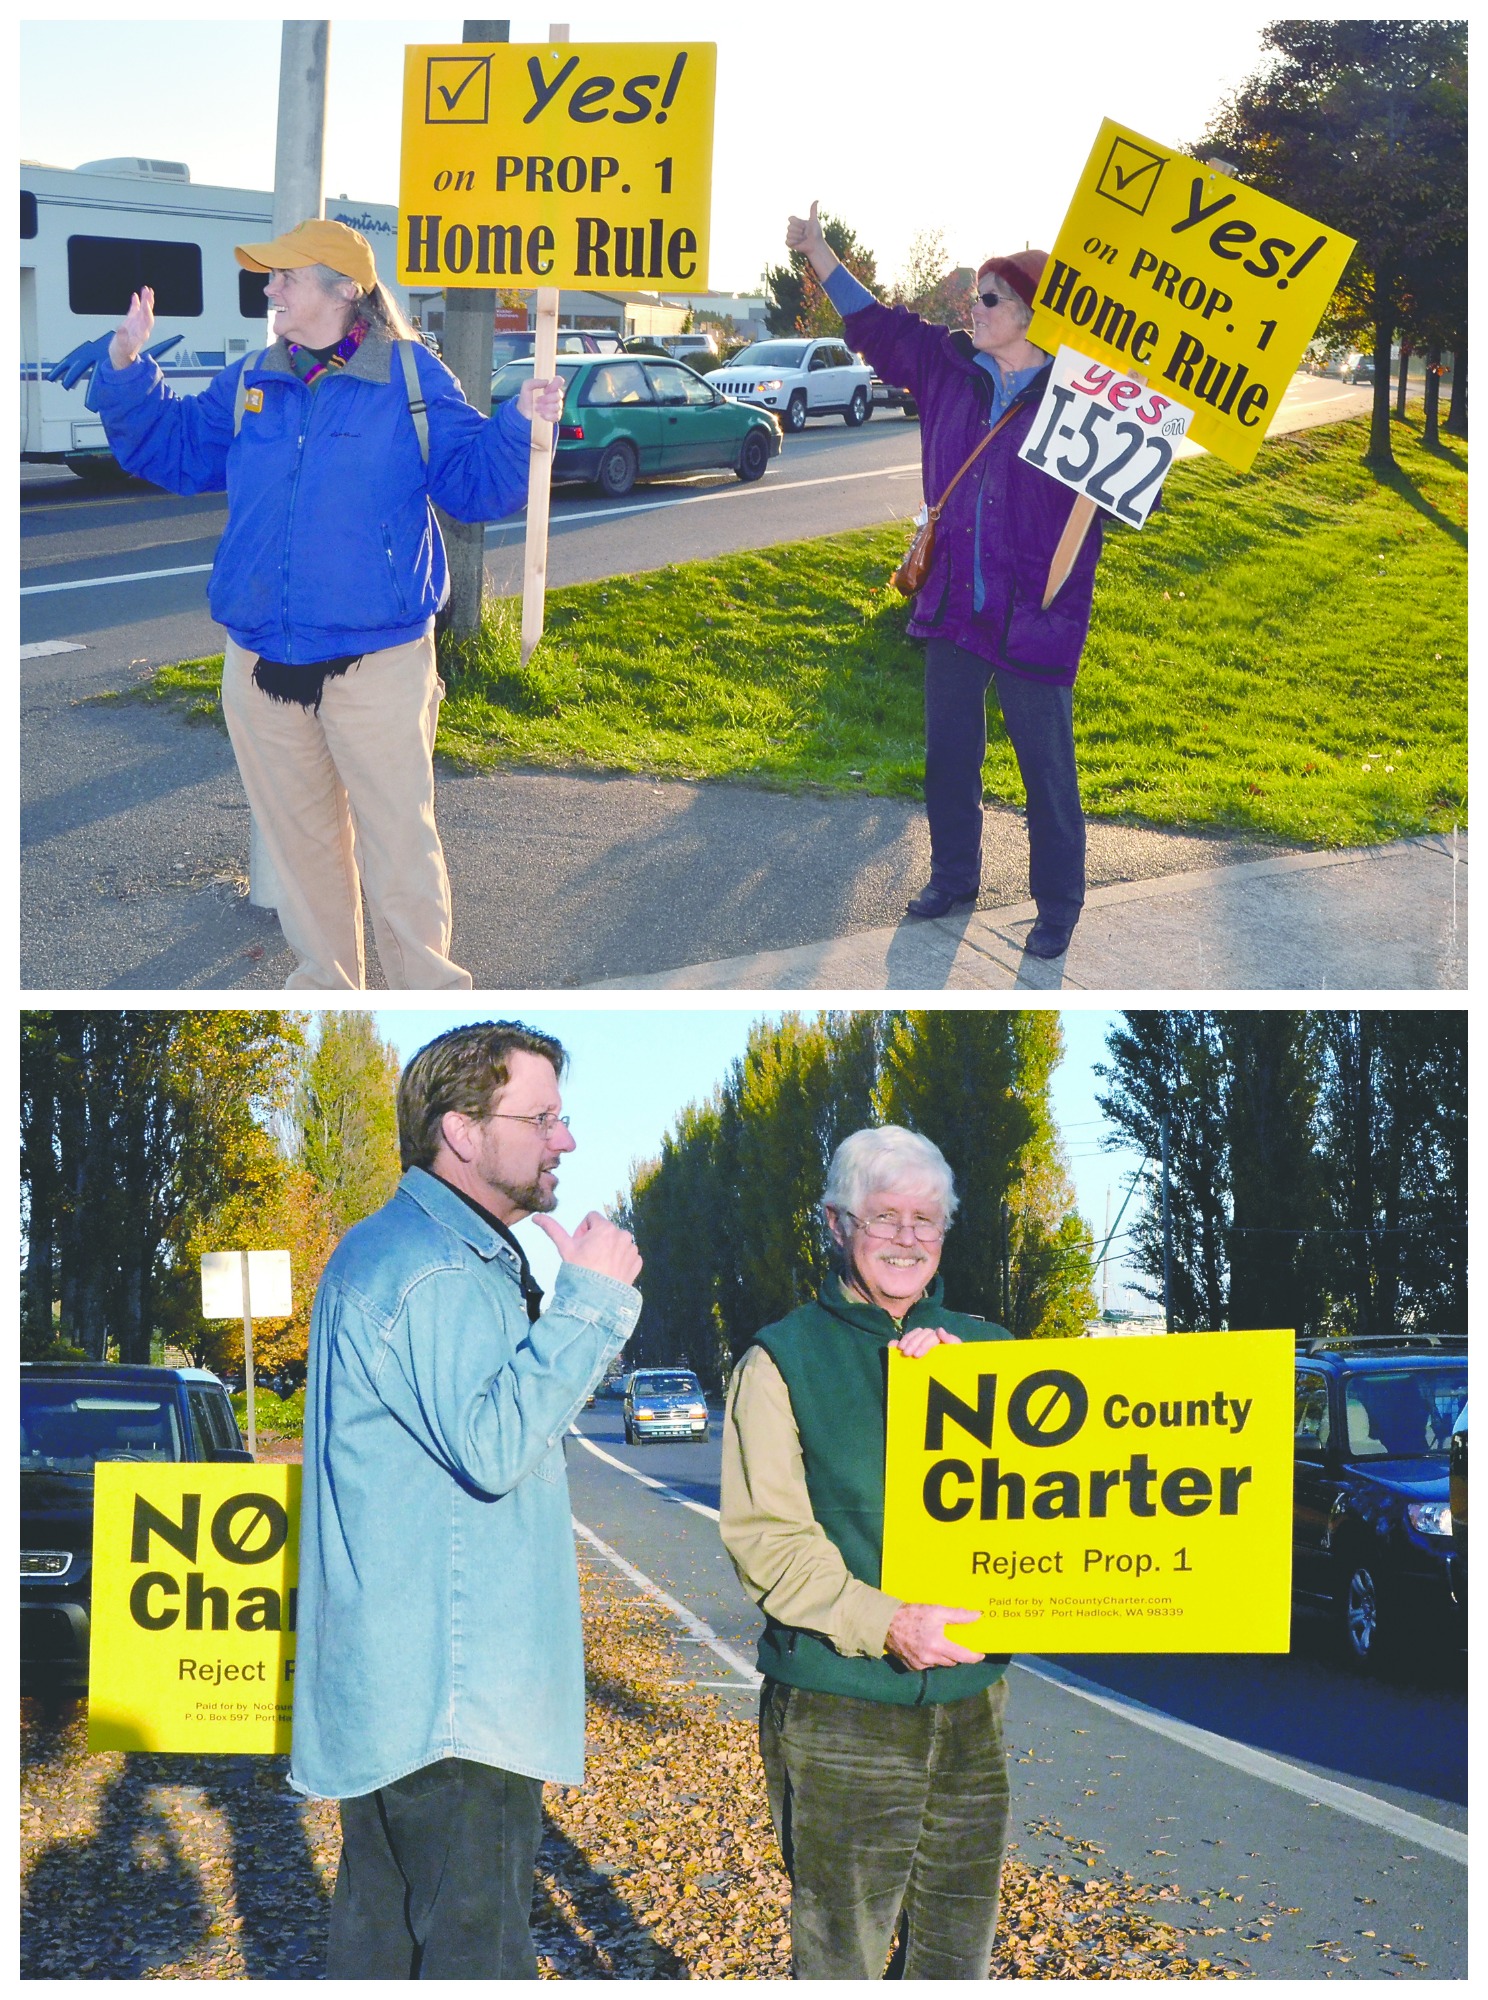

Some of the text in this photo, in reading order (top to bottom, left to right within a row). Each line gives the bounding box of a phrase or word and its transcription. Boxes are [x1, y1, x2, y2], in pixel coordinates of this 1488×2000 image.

[523, 51, 688, 124] Yes!
[433, 155, 673, 194] on PROP. 1
[405, 215, 697, 280] Home Rule
[1171, 177, 1327, 289] Yes!
[1083, 237, 1278, 352] on PROP. 1
[1040, 259, 1269, 427] Home Rule
[1070, 363, 1186, 437] yes on
[1025, 384, 1173, 525] I-522
[924, 1369, 1253, 1451] NO County
[922, 1453, 1252, 1523] Charter
[130, 1492, 288, 1565] NO
[971, 1547, 1193, 1580] Reject Prop. 1
[130, 1571, 298, 1633] Cha
[989, 1596, 1172, 1607] Paid for by NoCountyCharter.com
[989, 1610, 999, 1618] O.
[1003, 1610, 1021, 1618] Box
[1025, 1610, 1045, 1618] 597
[1051, 1609, 1073, 1617] Port
[1125, 1608, 1144, 1617] WA
[1147, 1608, 1184, 1617] 98339
[178, 1658, 266, 1686] Reject
[185, 1713, 193, 1721] P.
[196, 1713, 206, 1721] O.
[209, 1713, 227, 1721] Box
[230, 1713, 249, 1721] 597
[255, 1713, 276, 1722] Port
[195, 1702, 218, 1711] Paid
[220, 1702, 234, 1711] for
[236, 1702, 248, 1712] by
